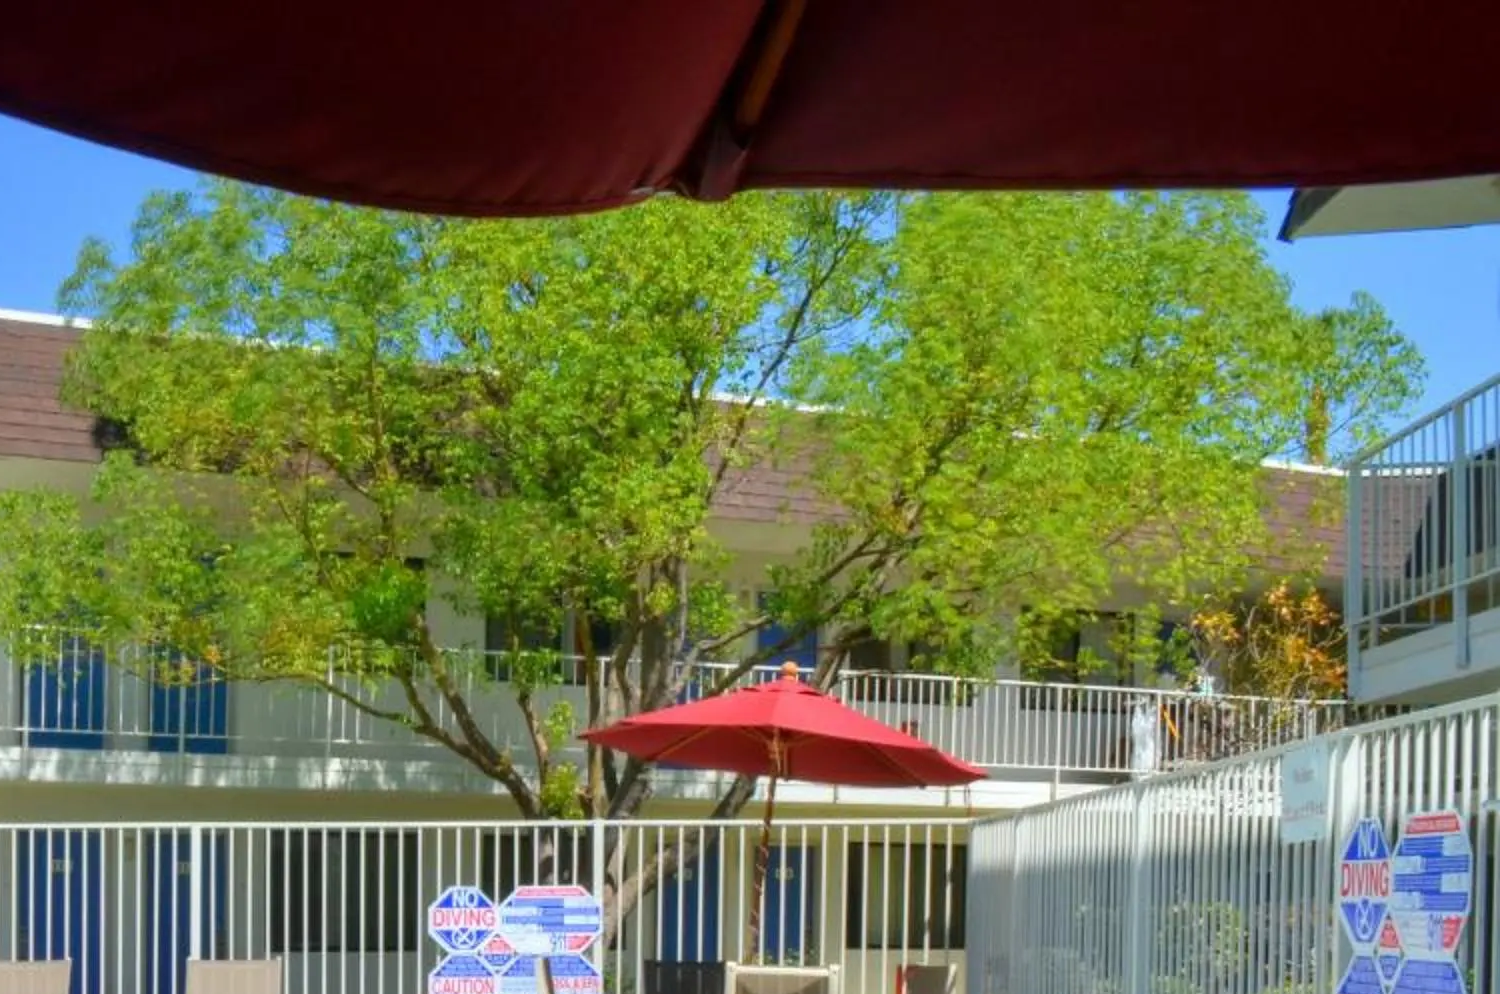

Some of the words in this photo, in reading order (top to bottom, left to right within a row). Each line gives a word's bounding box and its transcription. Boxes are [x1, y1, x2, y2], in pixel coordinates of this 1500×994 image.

[1357, 820, 1380, 859] NO
[1340, 862, 1389, 896] DIVING
[452, 890, 477, 907] NO
[432, 910, 496, 926] DIVING
[432, 978, 495, 994] CAUTION
